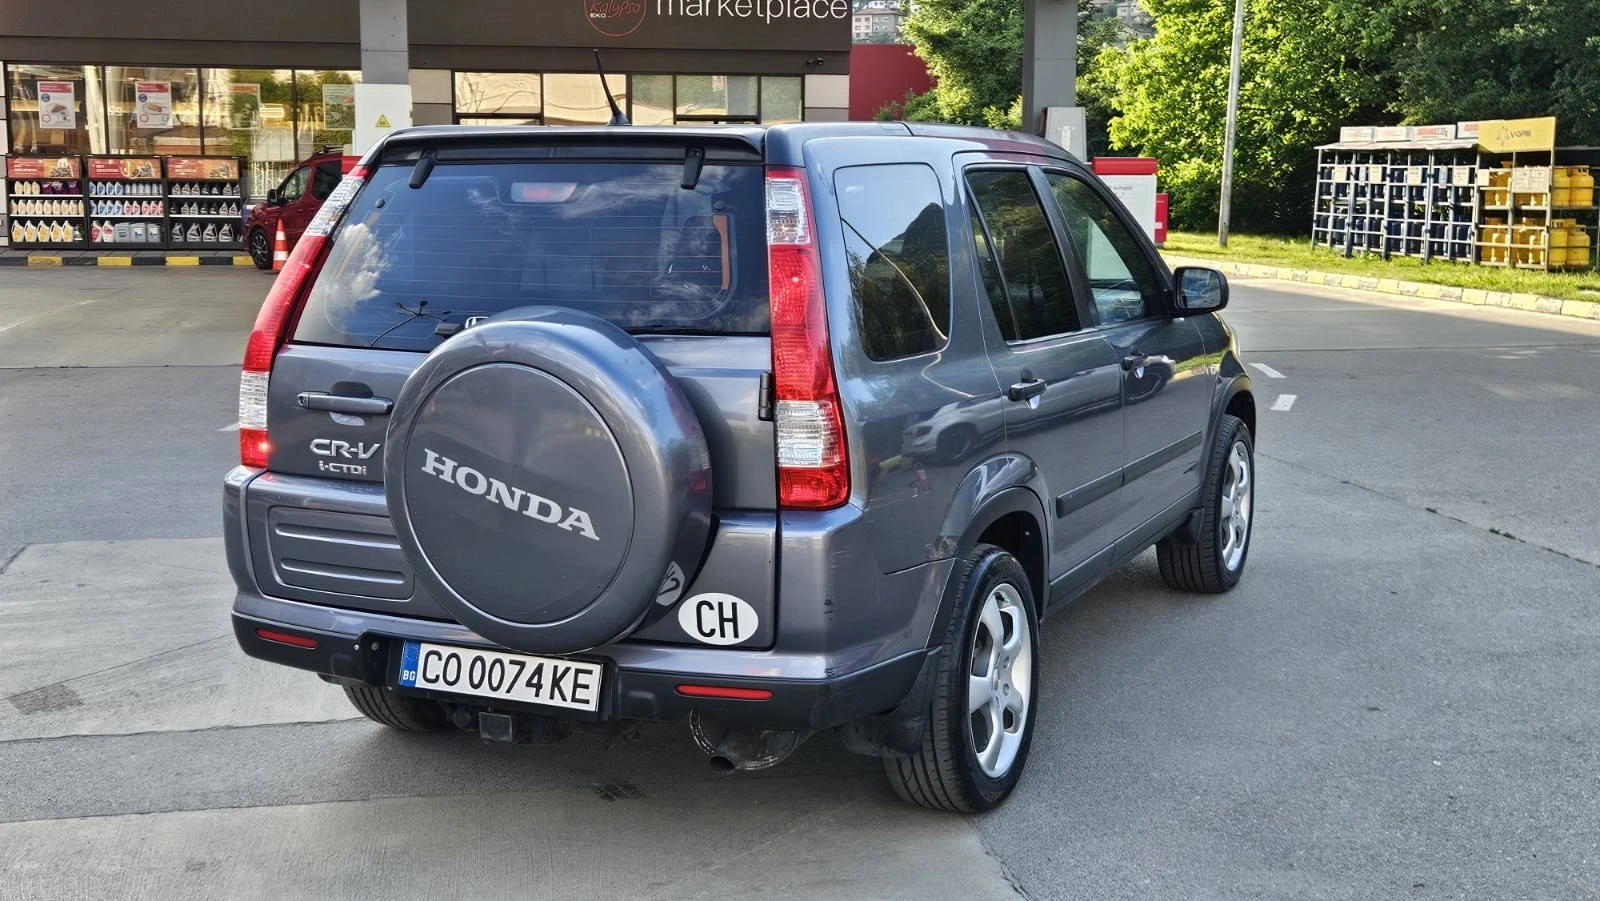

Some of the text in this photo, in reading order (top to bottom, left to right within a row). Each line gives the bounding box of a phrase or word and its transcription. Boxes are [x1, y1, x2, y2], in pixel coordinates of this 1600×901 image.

[656, 0, 848, 24] marketplace
[309, 438, 381, 459] CR-V
[421, 448, 600, 541] HONDA
[696, 600, 740, 639] CH
[402, 669, 416, 681] BG
